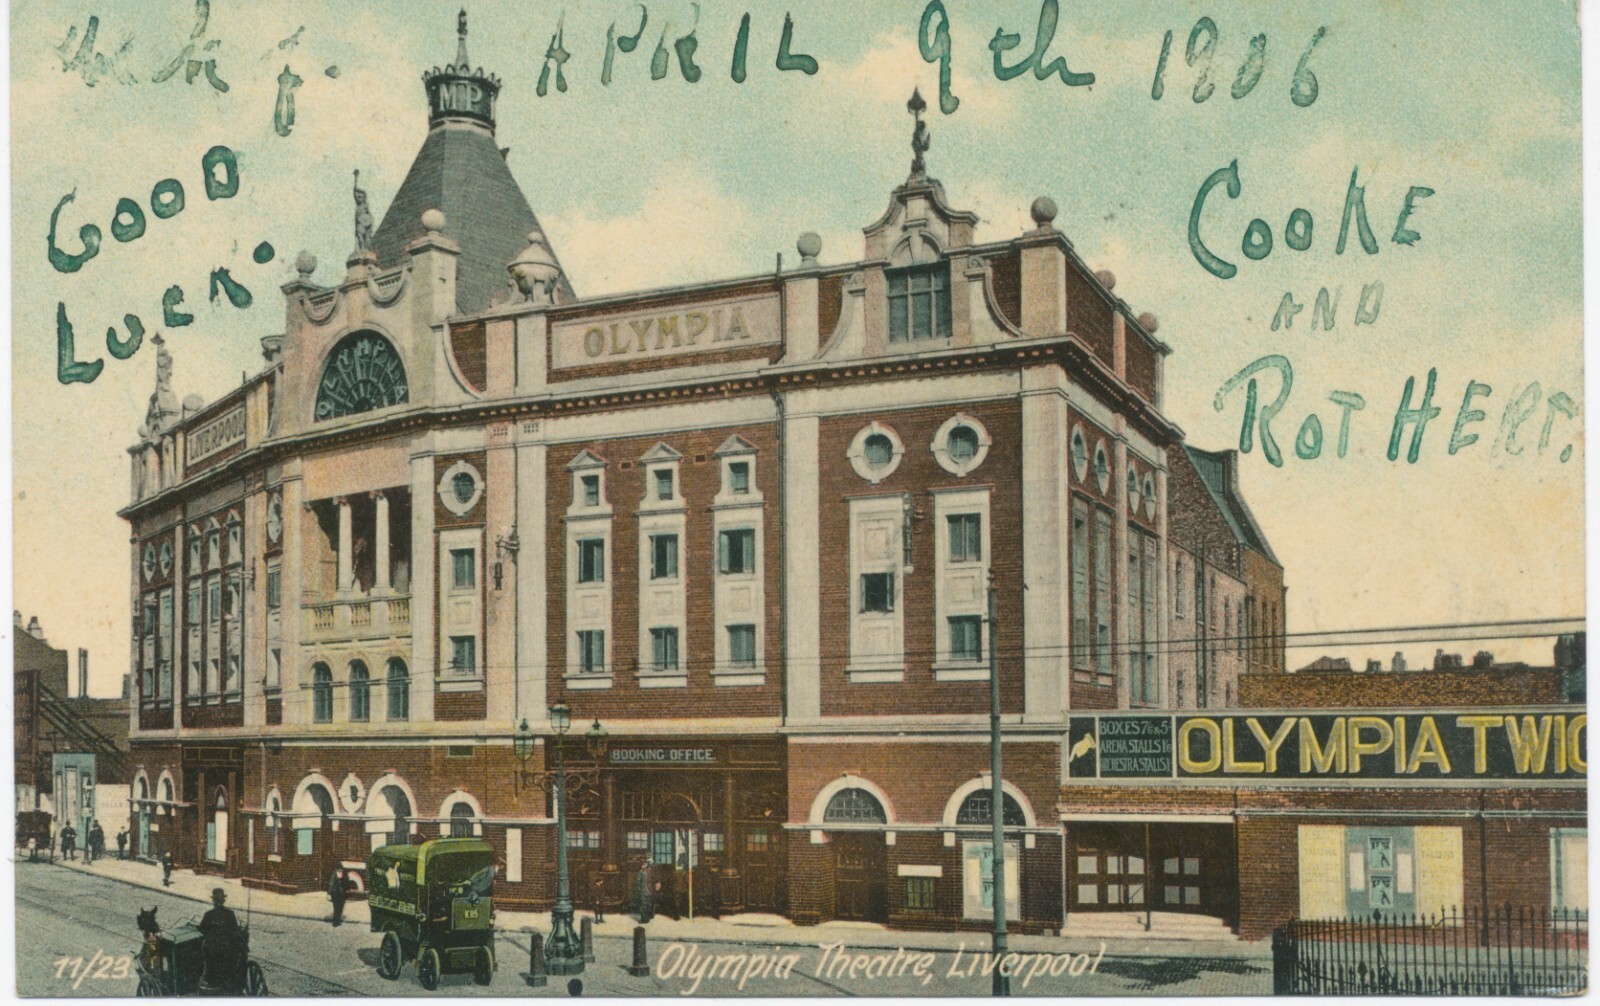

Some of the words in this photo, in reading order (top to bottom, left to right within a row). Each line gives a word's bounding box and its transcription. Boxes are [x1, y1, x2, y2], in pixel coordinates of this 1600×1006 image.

[1152, 16, 1326, 107] 1906
[583, 305, 751, 358] OLYMPIA
[1271, 279, 1385, 332] AND
[189, 408, 245, 461] LIVERPOOL
[1100, 720, 1140, 735] BOXES
[1100, 739, 1128, 753] ARENA
[1128, 739, 1161, 753] STALLS
[1178, 716, 1451, 774] OLYMPIA
[612, 749, 664, 760] BOOKING
[1139, 757, 1166, 772] STALLS
